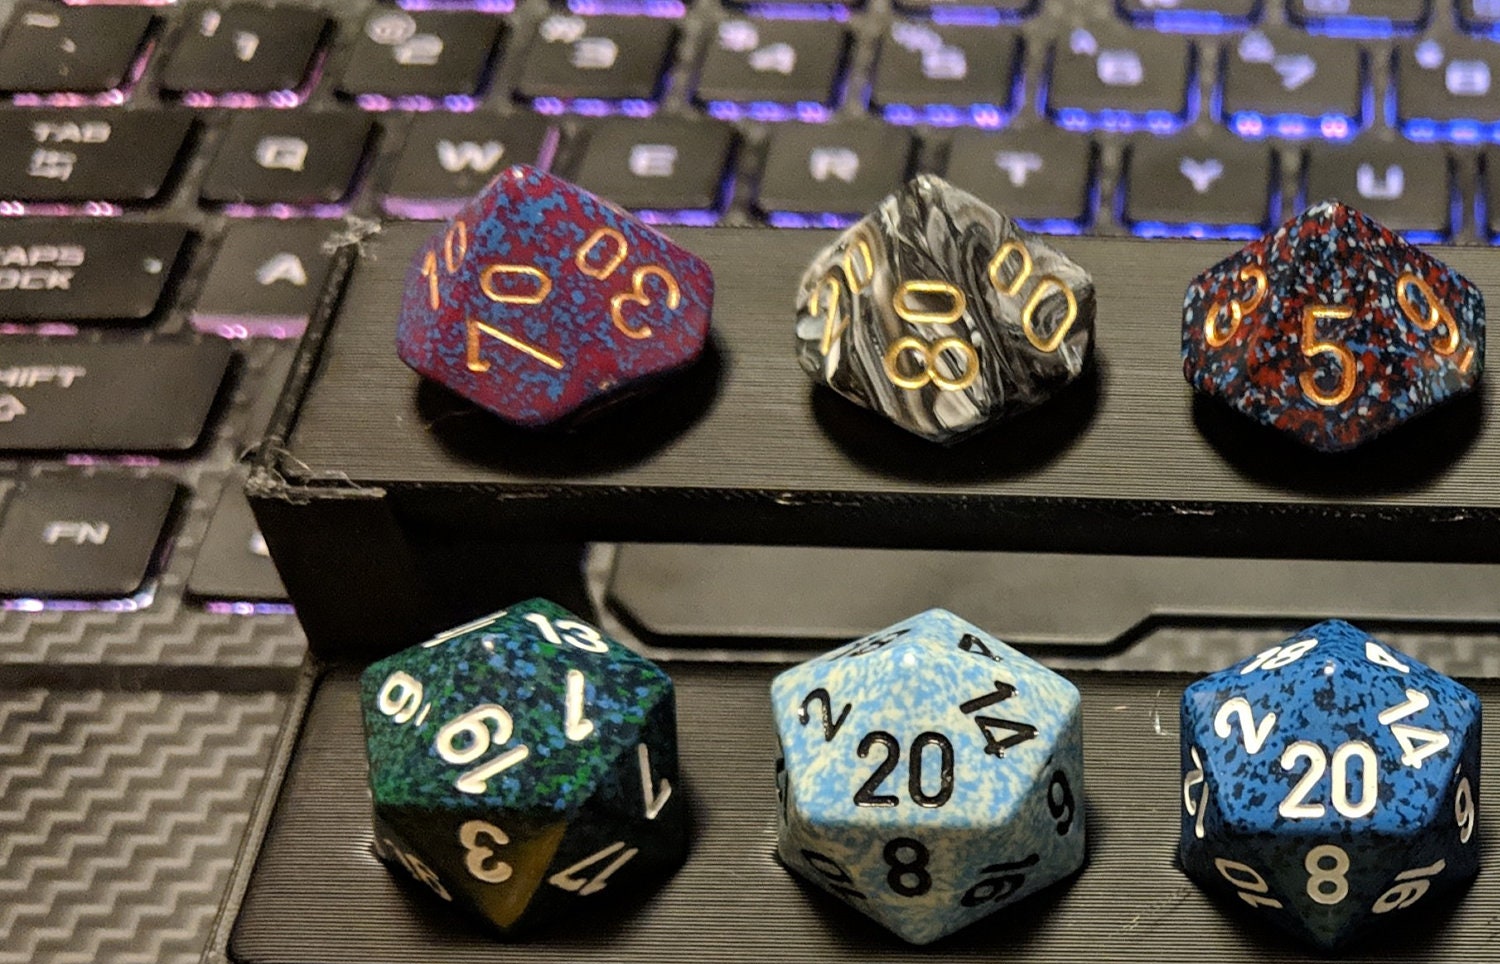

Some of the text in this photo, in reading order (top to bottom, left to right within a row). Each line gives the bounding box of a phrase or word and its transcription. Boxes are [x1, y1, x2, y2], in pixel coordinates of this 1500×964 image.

[256, 136, 309, 171] Q
[436, 139, 504, 172] W
[810, 149, 859, 182] R
[995, 151, 1043, 187] T
[1180, 156, 1224, 192] Y
[1356, 163, 1404, 199] U
[0, 245, 86, 267] APS
[0, 269, 76, 290] OCK
[256, 253, 308, 286] A
[882, 279, 981, 390] 80
[1298, 302, 1359, 407] 5
[44, 520, 110, 545] FN
[523, 612, 610, 653] 13
[799, 687, 853, 742] 2
[958, 680, 1040, 759] 14
[1213, 696, 1277, 755] 2
[1377, 688, 1451, 770] 14
[853, 730, 955, 809] 20
[1278, 740, 1379, 819] 20
[458, 820, 514, 884] 3
[882, 836, 933, 898] 8
[1304, 844, 1350, 905] 8
